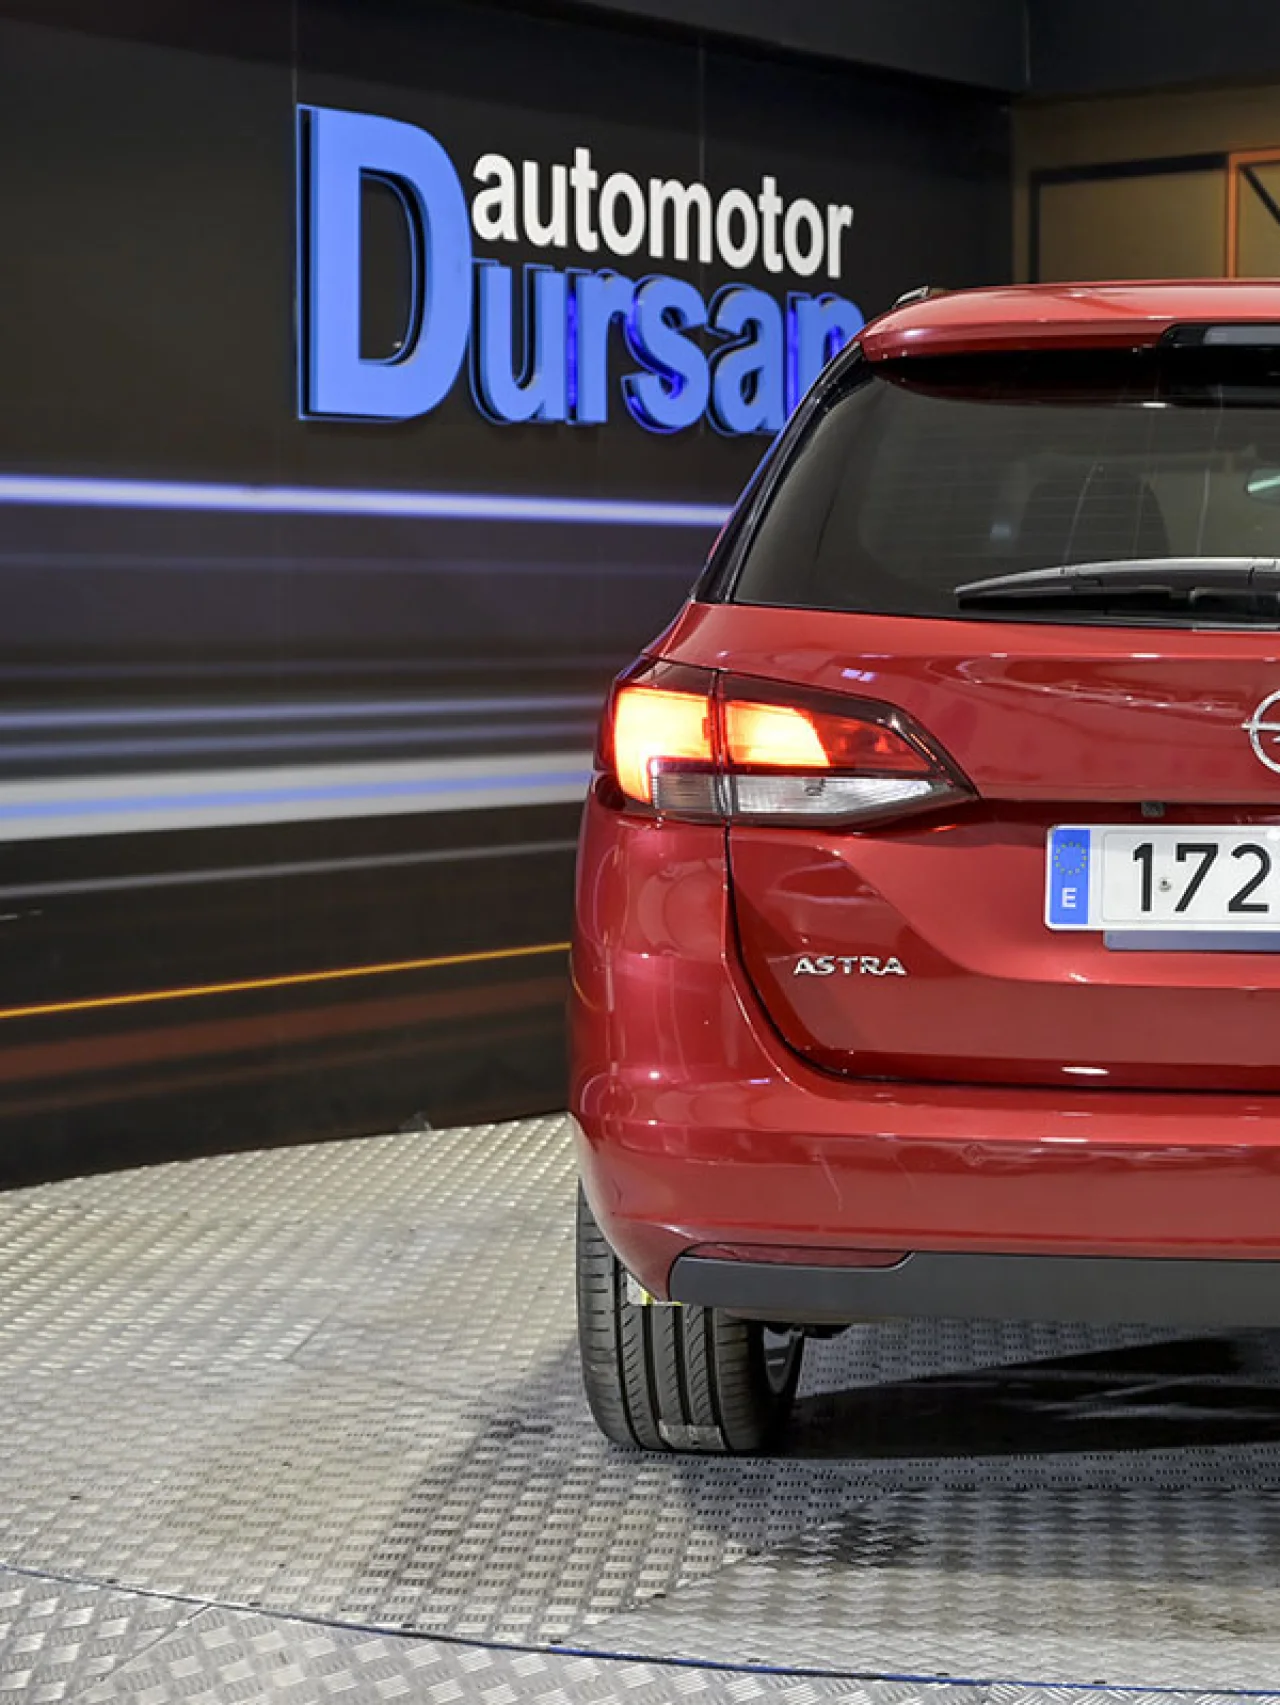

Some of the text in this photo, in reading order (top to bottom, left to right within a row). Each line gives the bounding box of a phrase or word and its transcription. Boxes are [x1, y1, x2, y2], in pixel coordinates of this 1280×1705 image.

[471, 147, 853, 278] automotor
[296, 103, 864, 436] Dursan
[1061, 887, 1078, 909] E
[793, 955, 907, 976] ASTRA
